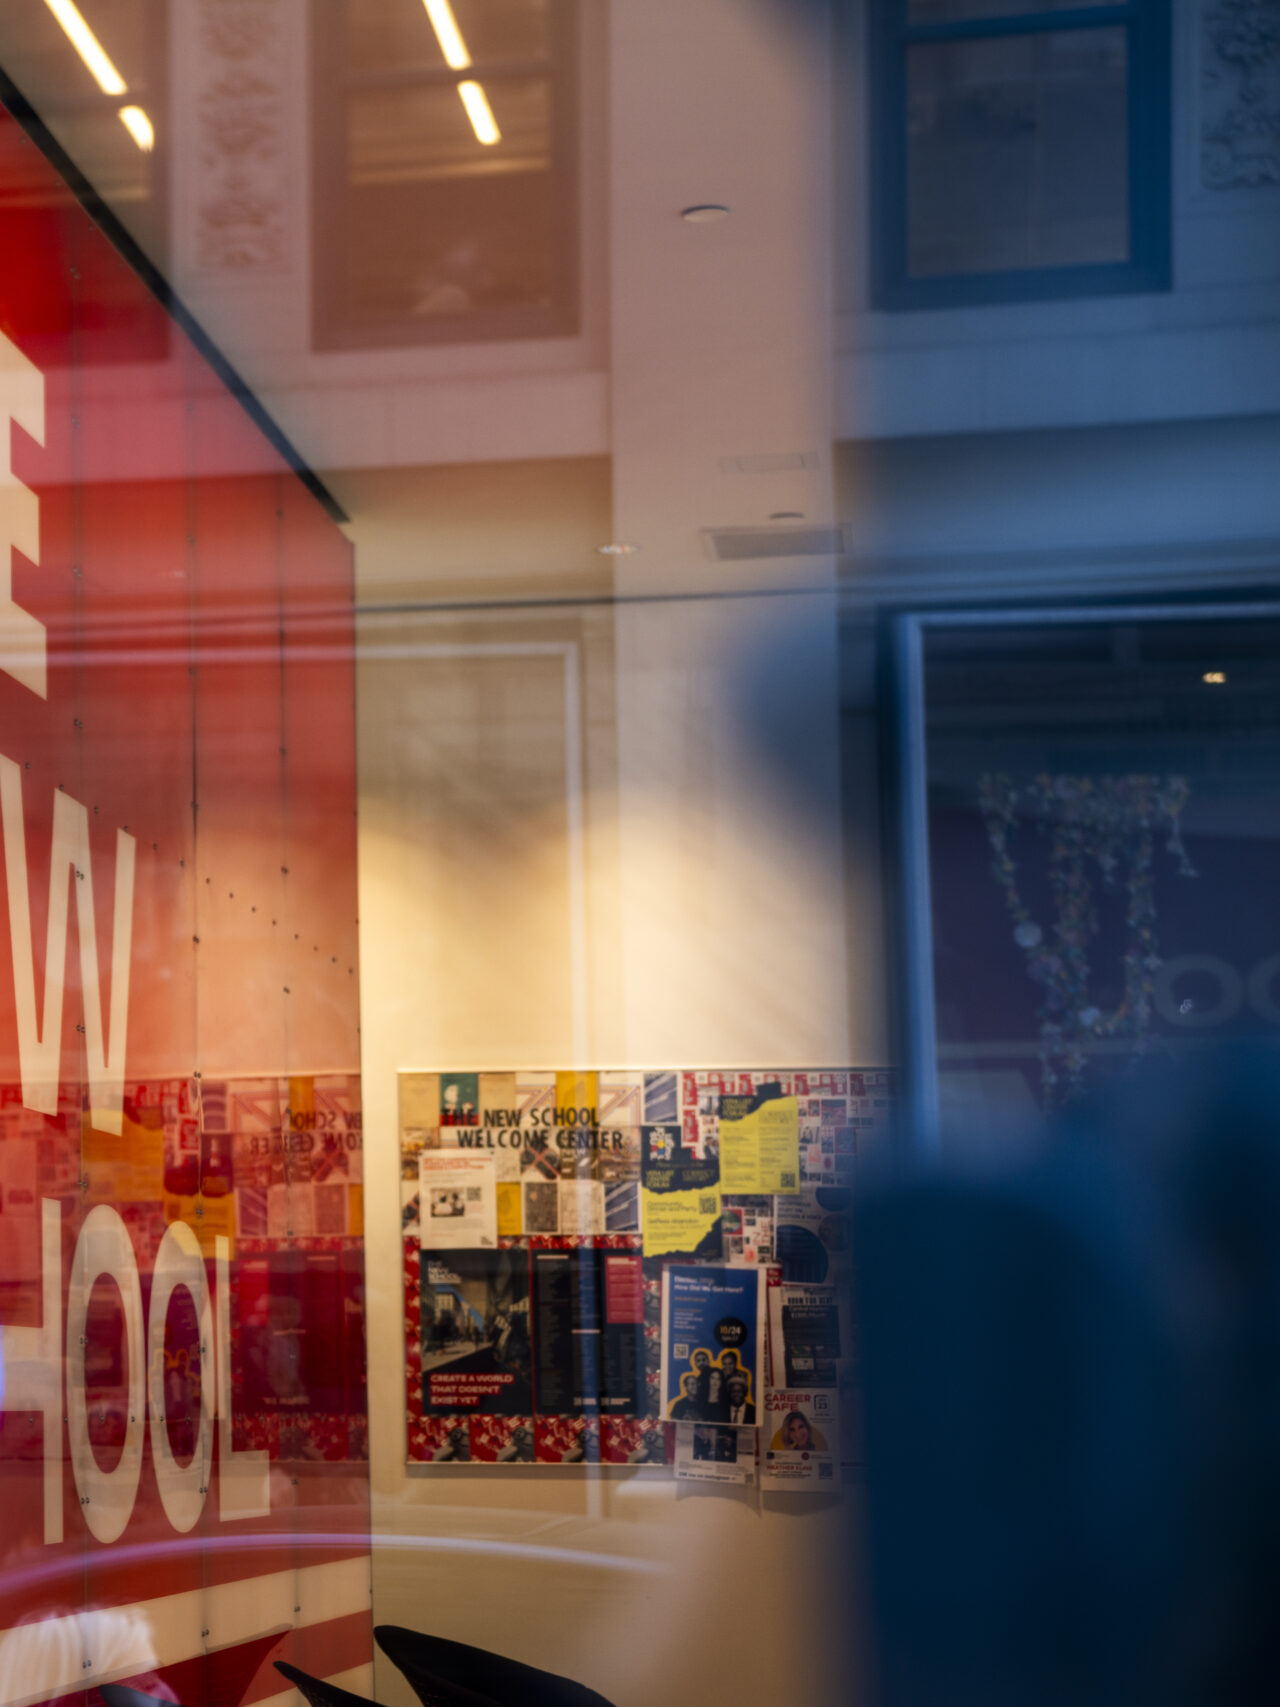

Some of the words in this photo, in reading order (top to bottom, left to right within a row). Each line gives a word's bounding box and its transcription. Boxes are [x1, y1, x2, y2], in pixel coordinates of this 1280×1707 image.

[442, 1108, 477, 1126] THE
[484, 1109, 521, 1127] NEW
[529, 1107, 600, 1128] SCHOOL
[456, 1129, 549, 1149] WELCOME
[555, 1130, 624, 1150] CENTER
[430, 1374, 468, 1383] CREATE
[469, 1374, 476, 1383] A
[477, 1374, 514, 1383] WORLD
[431, 1385, 457, 1394] THAT
[431, 1396, 458, 1405] EXIST
[459, 1396, 478, 1405] YET
[765, 1393, 811, 1404] CAREER
[765, 1403, 800, 1412] CAFE
